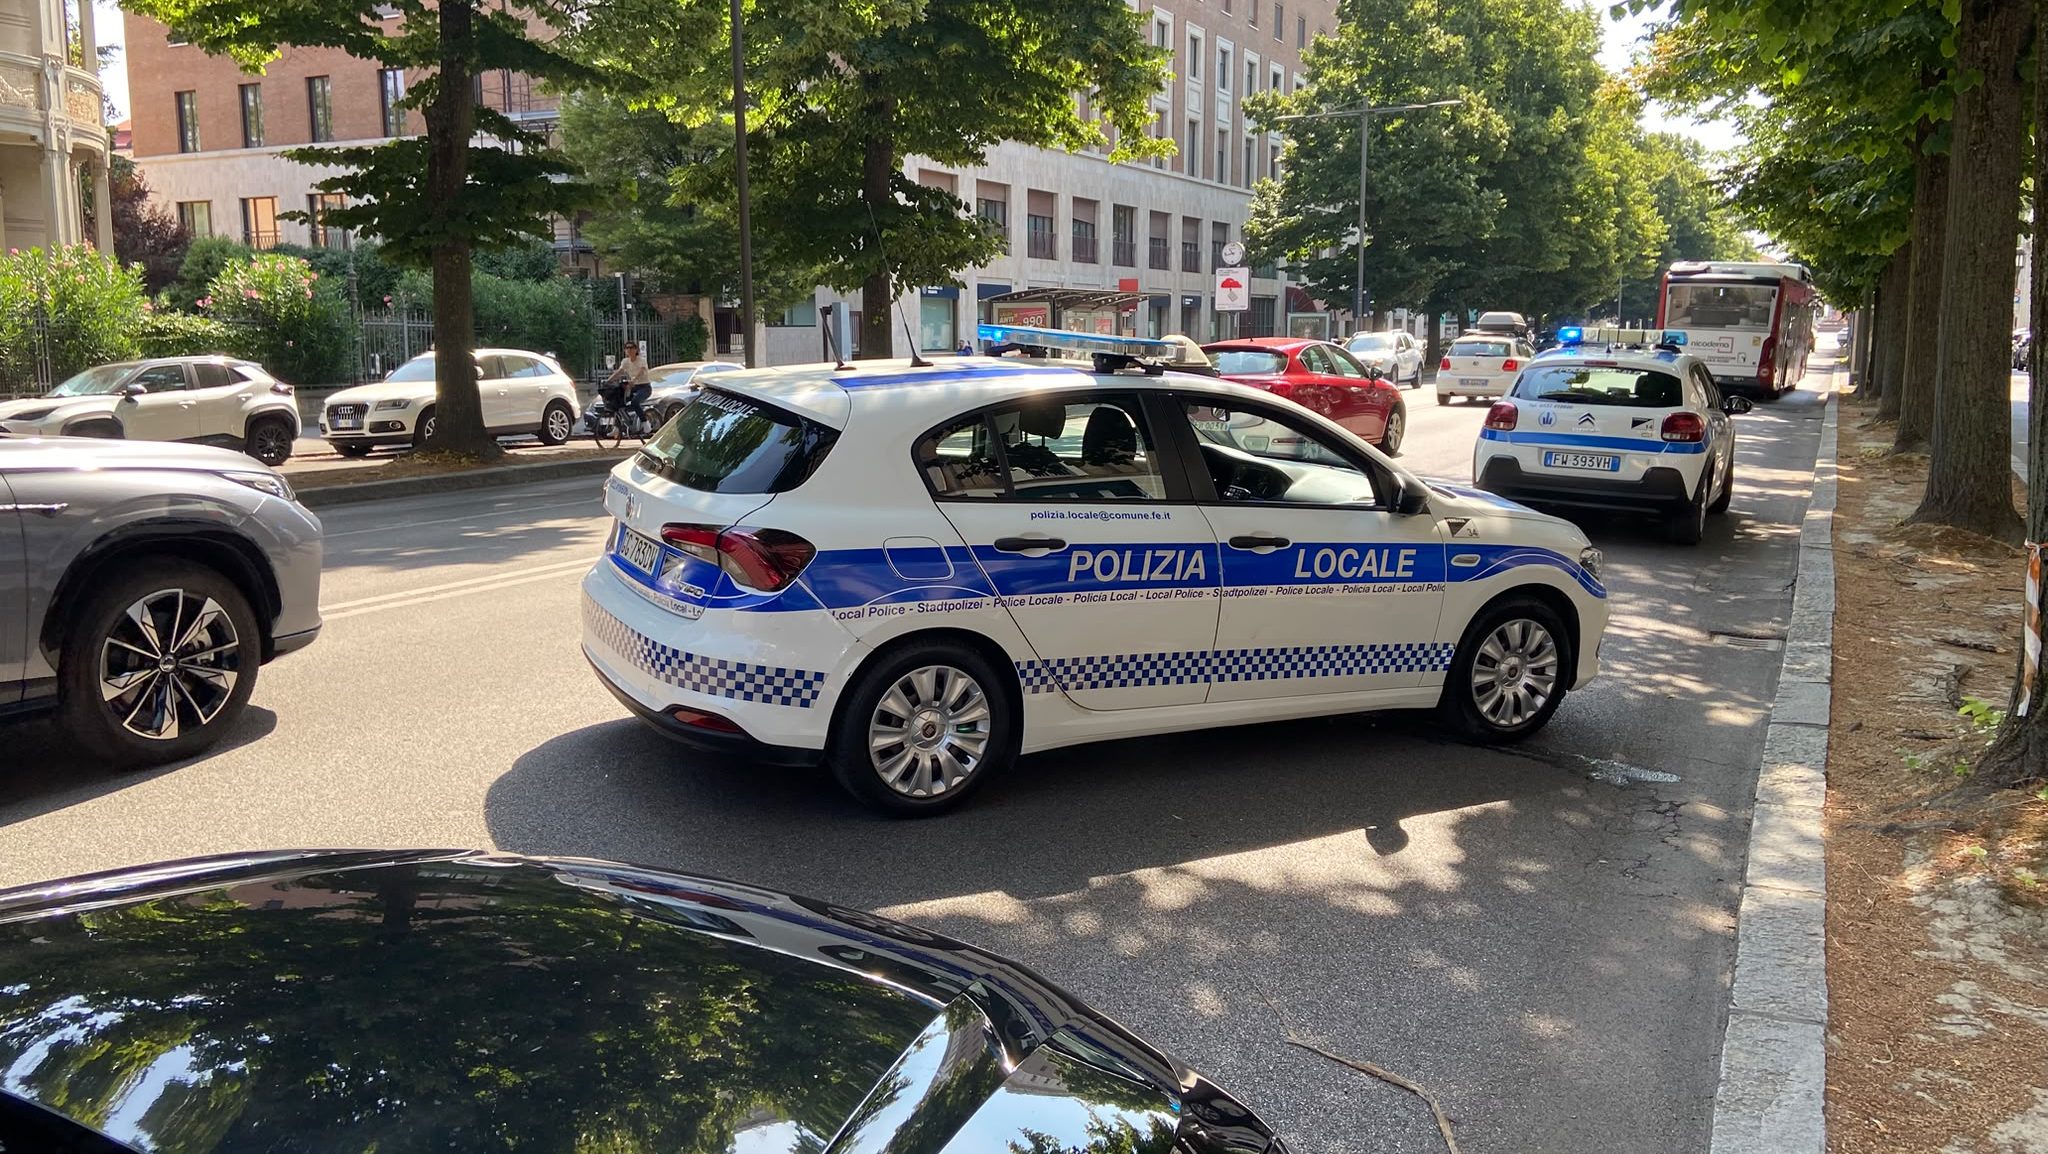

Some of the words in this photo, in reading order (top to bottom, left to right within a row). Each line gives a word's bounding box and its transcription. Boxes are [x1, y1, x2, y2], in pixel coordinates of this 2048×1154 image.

[1691, 339, 1730, 348] nicodemo
[718, 397, 759, 418] LOCALE
[1553, 453, 1569, 466] FW
[1572, 455, 1611, 469] 393VH
[1030, 510, 1171, 521] polizia.locale@comune.fe.it
[630, 537, 658, 572] 783DW
[1067, 549, 1206, 582] POLIZIA
[1294, 548, 1417, 579] LOCALE
[832, 608, 864, 620] Local
[869, 606, 905, 617] Police
[917, 600, 983, 613] Stadtpolizei
[993, 598, 1025, 607] Police
[1029, 595, 1063, 605] Locale
[1110, 591, 1138, 601] Local
[1146, 590, 1173, 599] Local
[1174, 588, 1204, 598] Police
[1212, 587, 1268, 598] Sadtpolizei
[1276, 586, 1303, 595] Police
[1305, 585, 1334, 594] Locale
[1372, 584, 1396, 593] Local
[1402, 583, 1425, 592] Local
